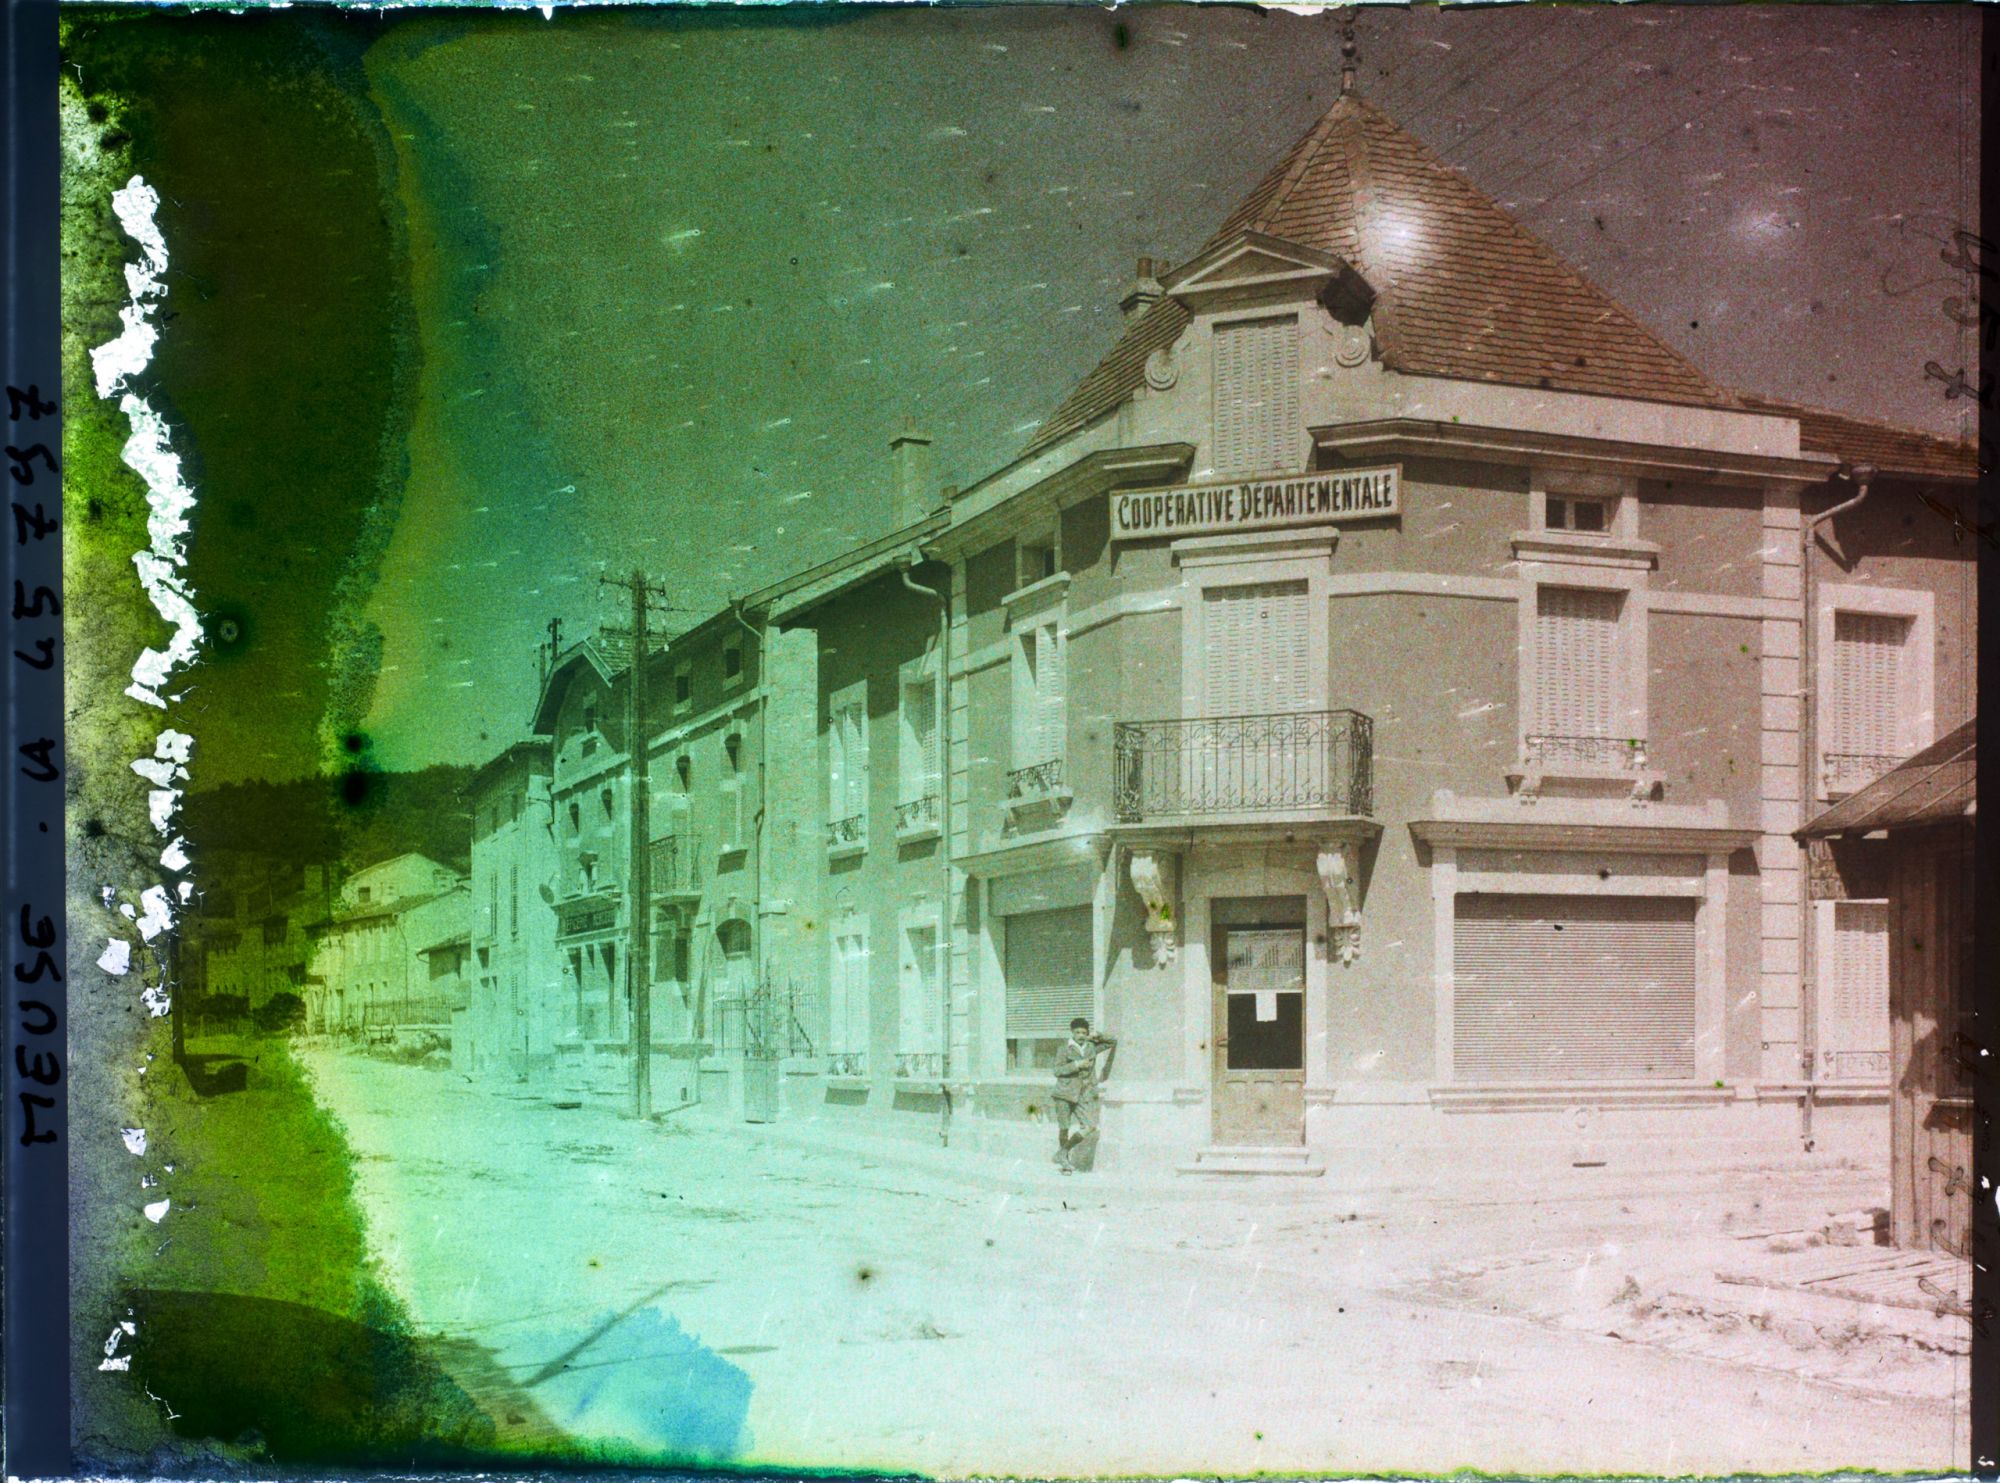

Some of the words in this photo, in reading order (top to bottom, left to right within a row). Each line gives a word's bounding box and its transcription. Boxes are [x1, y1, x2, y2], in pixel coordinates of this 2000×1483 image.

[1118, 488, 1234, 530] COOPÉRATIVE
[1239, 473, 1393, 522] DÉPARTEMENTALE
[18, 737, 60, 783] A
[14, 903, 62, 1147] MEUSE
